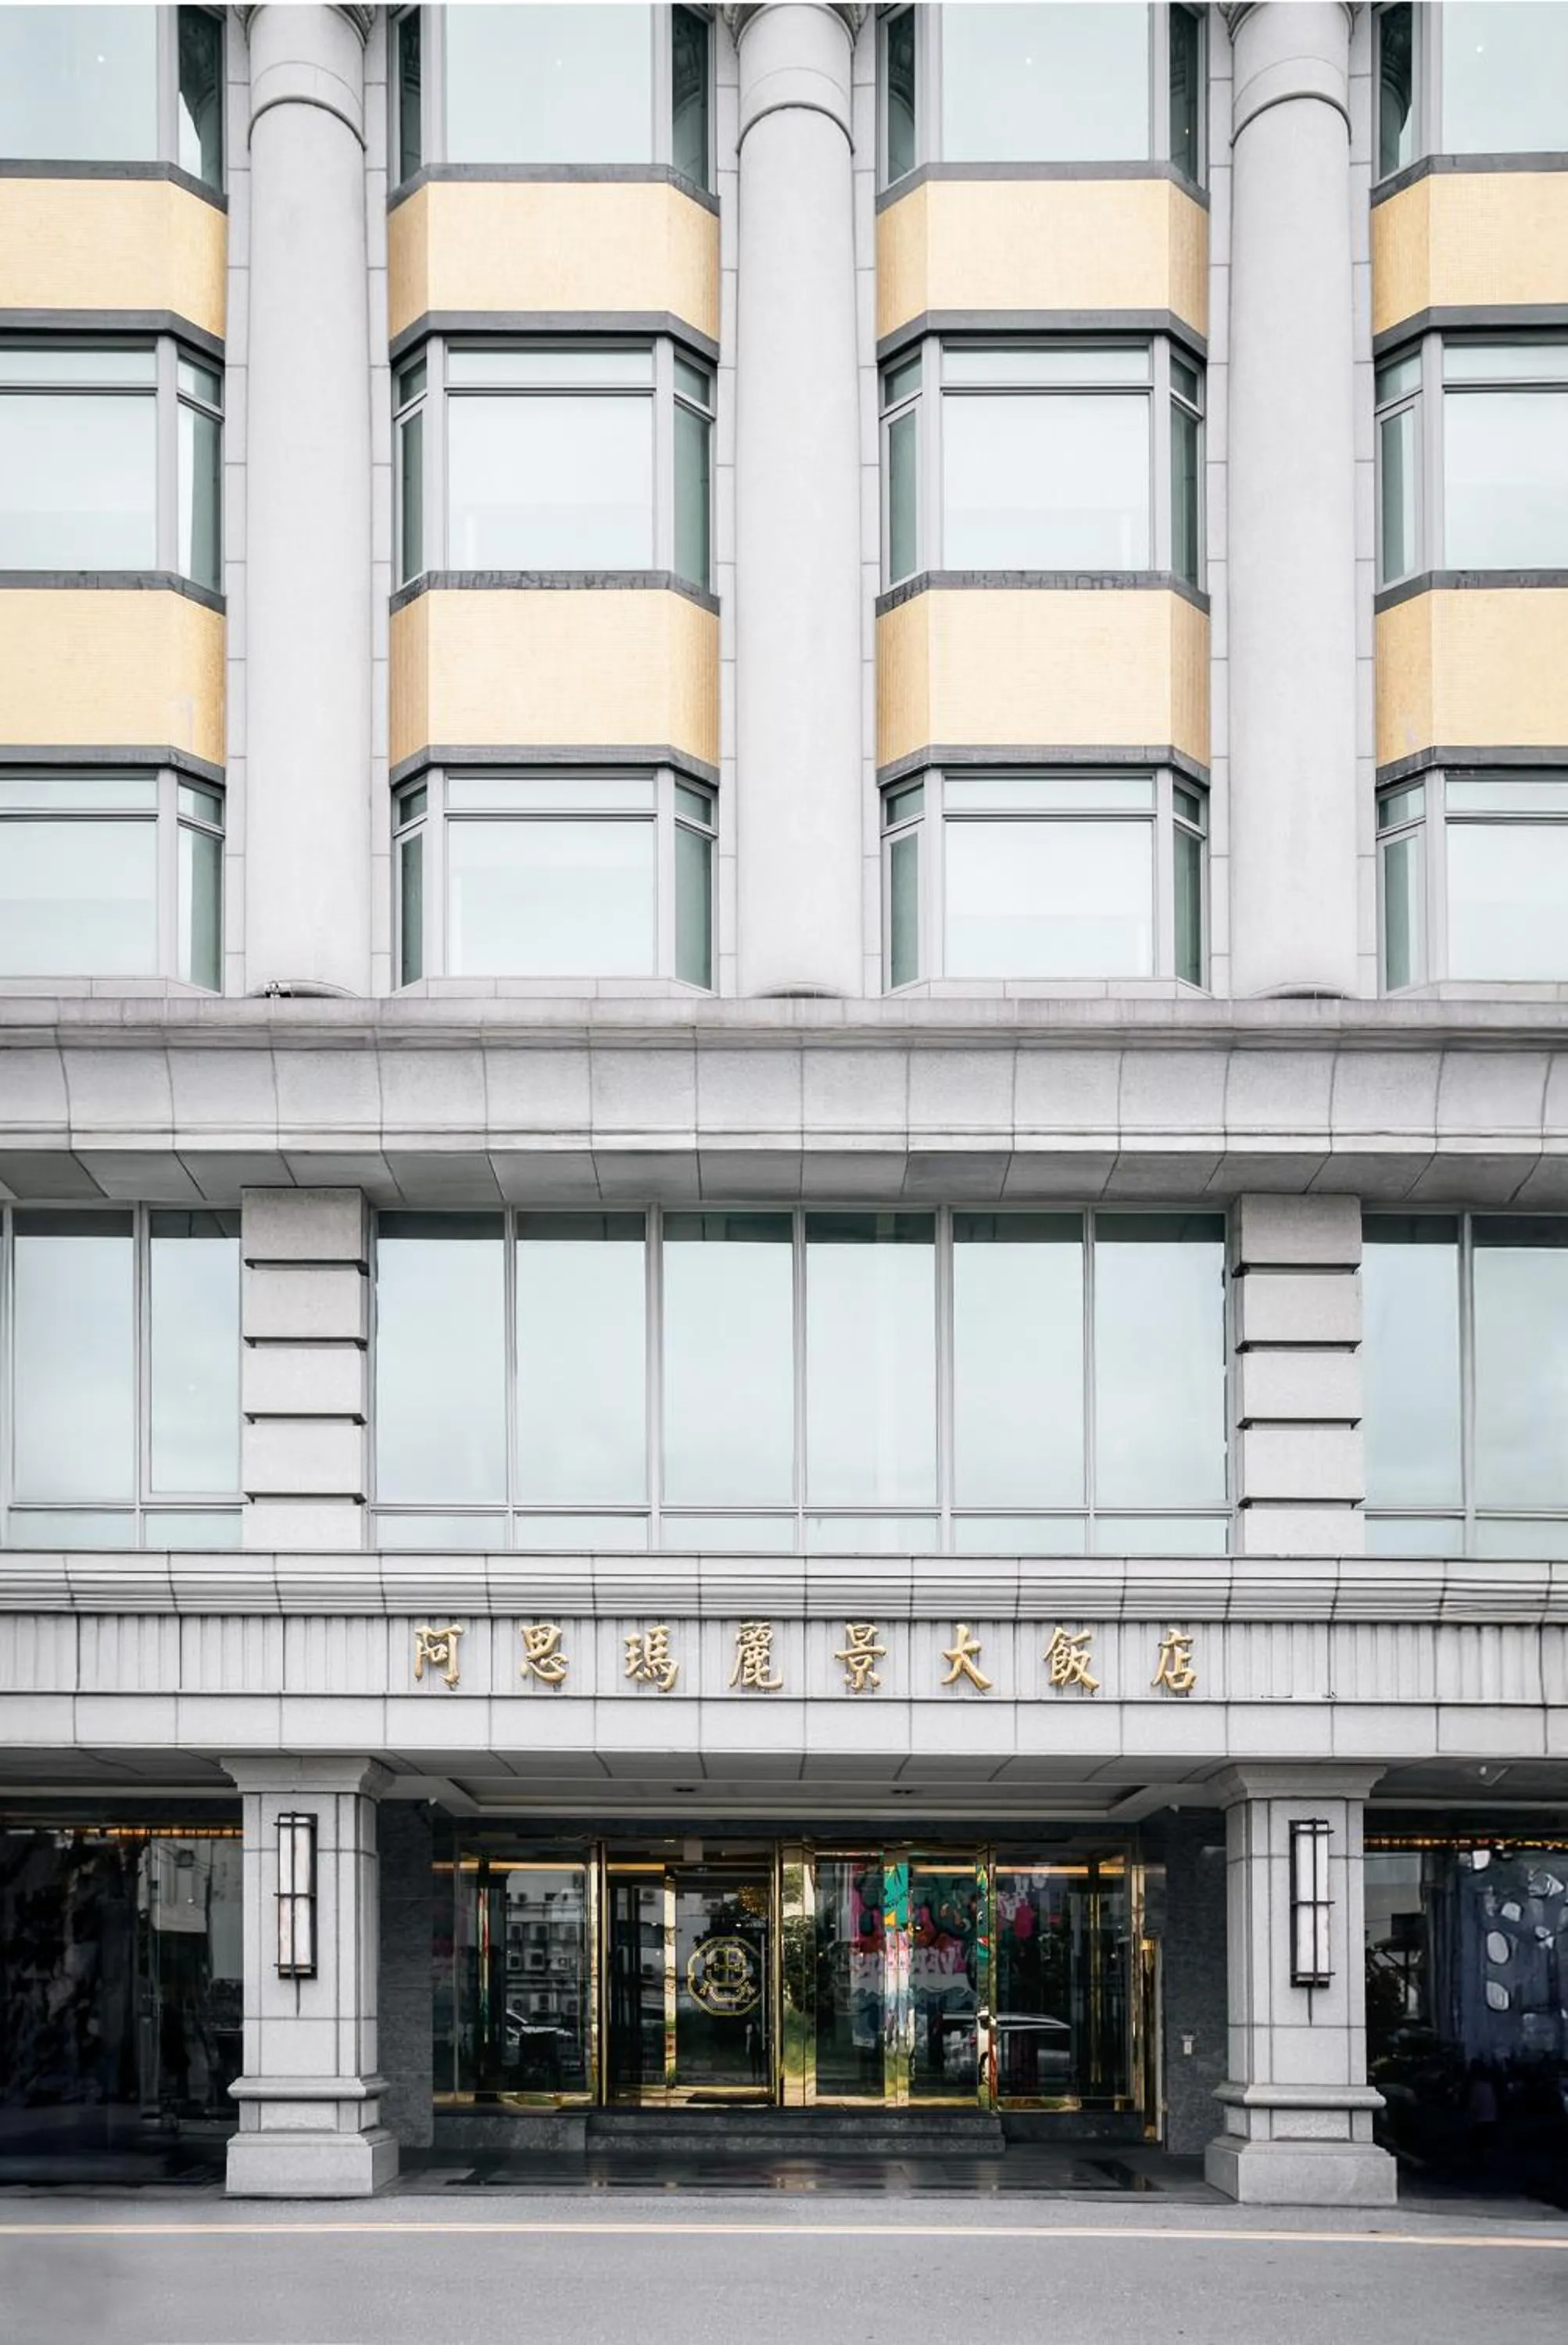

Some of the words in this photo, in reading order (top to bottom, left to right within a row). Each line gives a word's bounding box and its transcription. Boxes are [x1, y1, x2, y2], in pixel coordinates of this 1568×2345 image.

[414, 1621, 1197, 1692] 阿思瑪麗景大飯店
